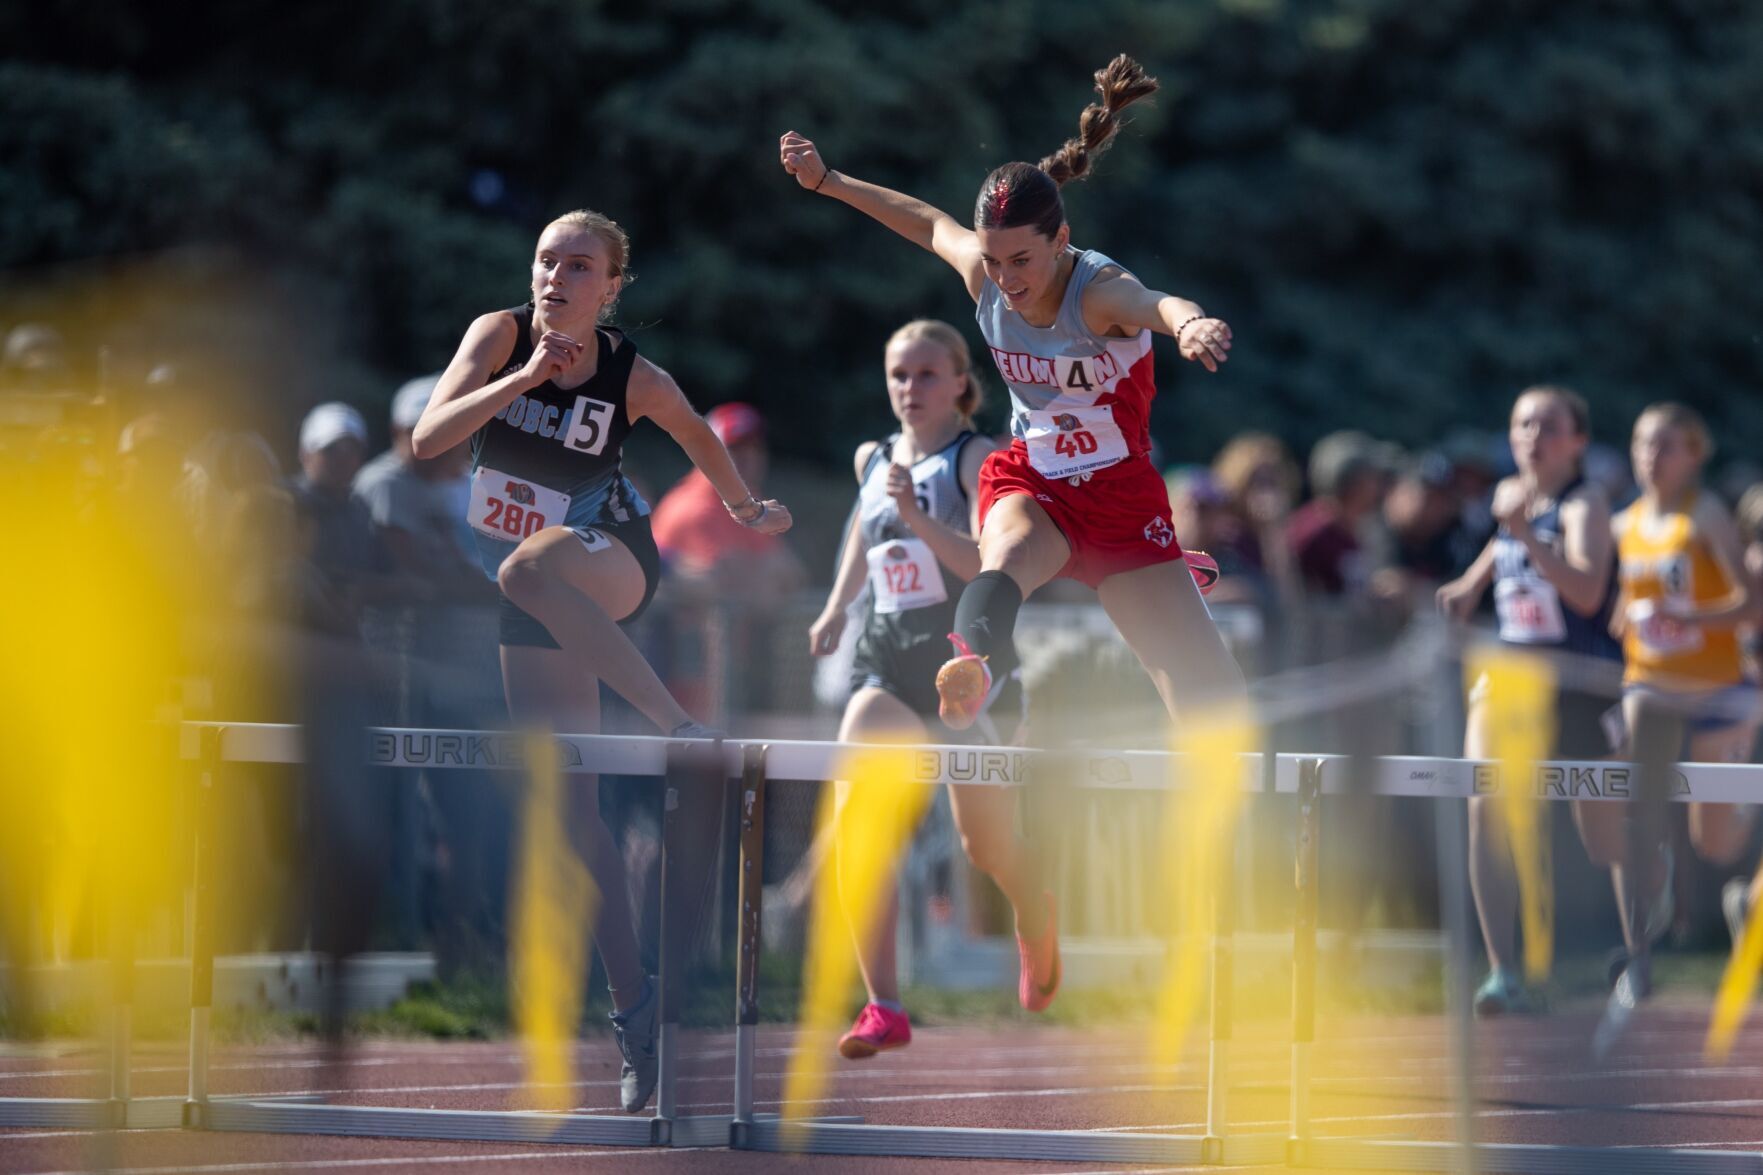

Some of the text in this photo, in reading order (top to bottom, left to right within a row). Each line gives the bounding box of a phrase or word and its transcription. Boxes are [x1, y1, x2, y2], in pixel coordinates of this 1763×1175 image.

[1066, 360, 1094, 391] 4
[573, 401, 606, 450] 5
[1054, 430, 1098, 459] 40
[483, 497, 545, 539] 280
[572, 527, 605, 545] 5
[884, 562, 924, 593] 122
[1472, 765, 1630, 798] BRKE
